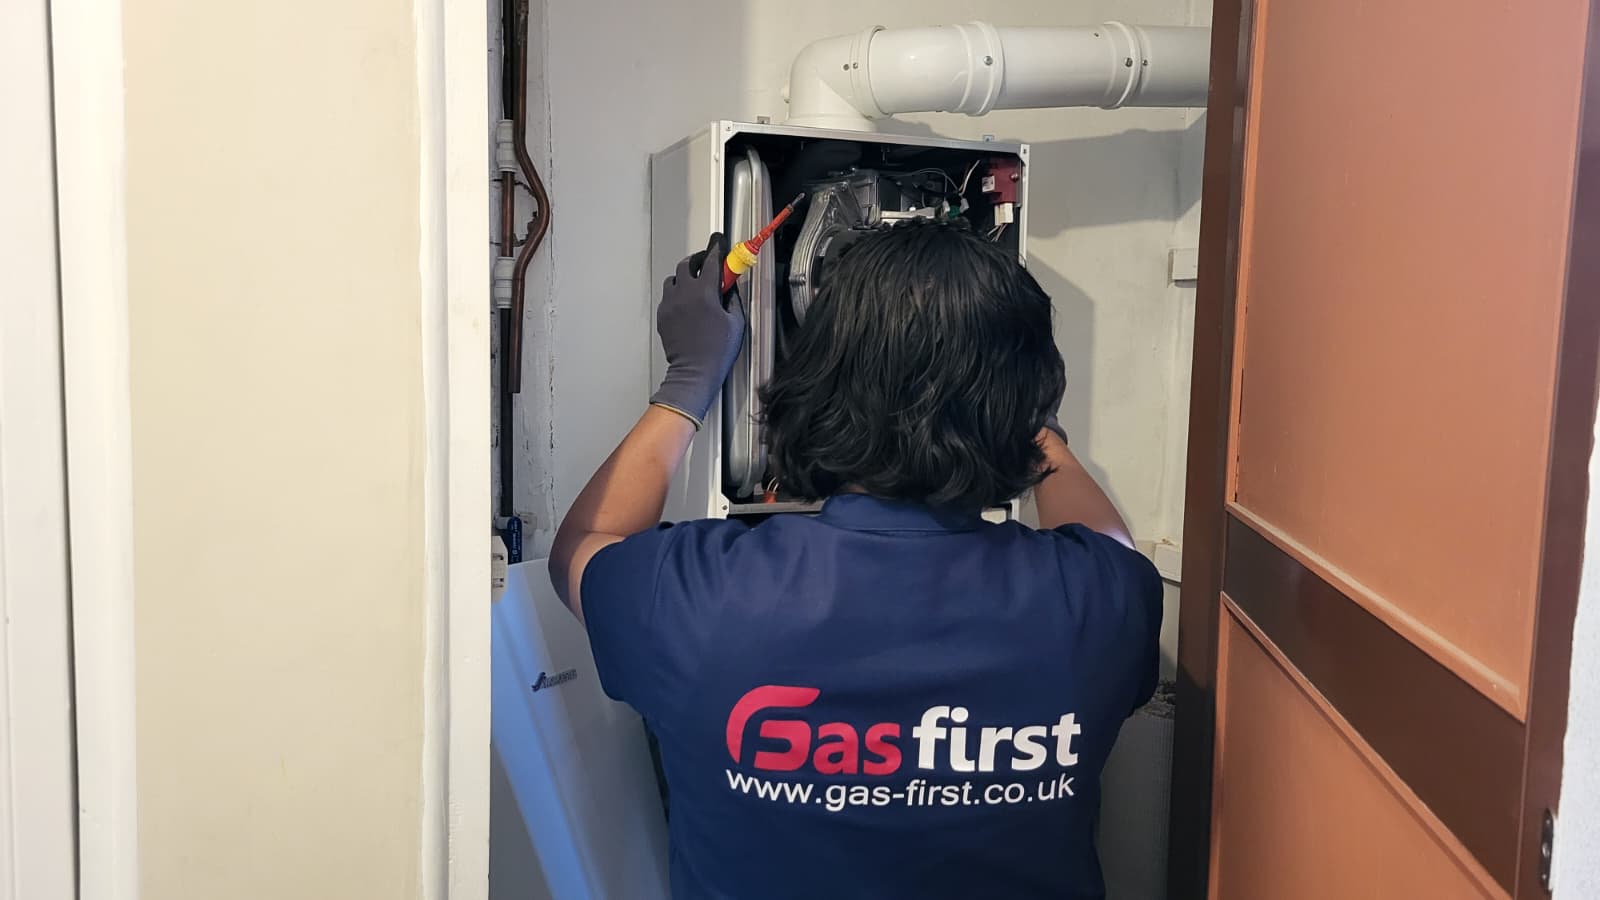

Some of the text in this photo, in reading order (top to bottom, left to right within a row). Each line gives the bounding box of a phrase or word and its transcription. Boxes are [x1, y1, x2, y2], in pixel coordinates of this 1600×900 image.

[726, 685, 1081, 775] Gas first
[725, 769, 1075, 812] www.gas-first.co.uk
